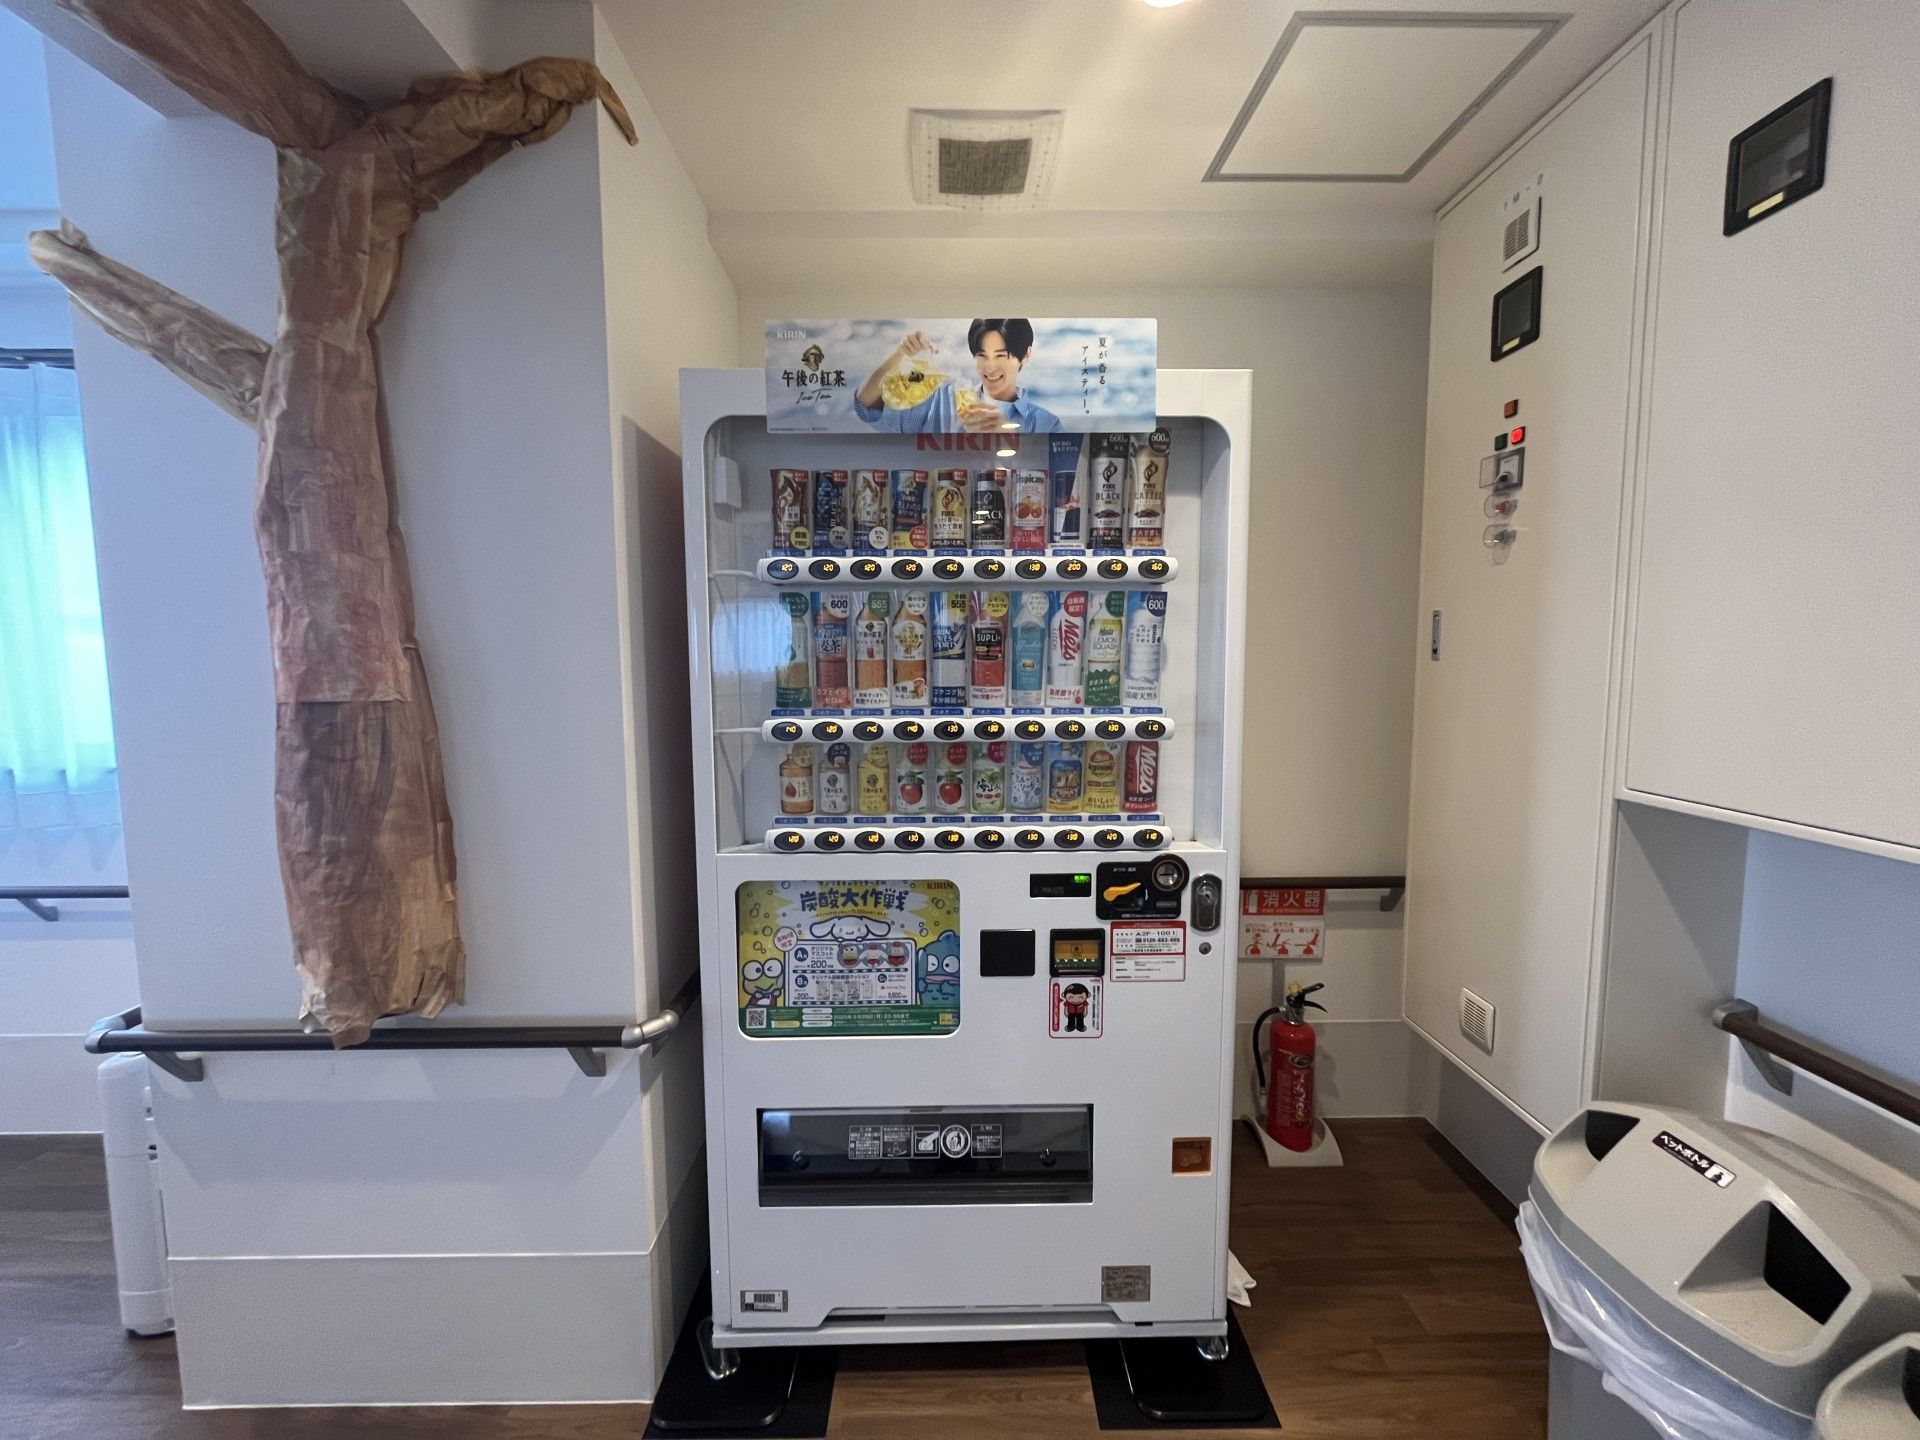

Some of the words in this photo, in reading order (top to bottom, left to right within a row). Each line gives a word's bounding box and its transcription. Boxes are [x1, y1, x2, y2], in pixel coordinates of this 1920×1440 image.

[776, 330, 806, 340] KIRIN
[781, 369, 847, 388] 午後の紅茶
[1095, 493, 1121, 501] BLACK
[831, 600, 848, 609] 600
[1148, 600, 1164, 610] 600
[800, 888, 909, 912] 炭酸大作戦
[1263, 888, 1321, 908] 消火器
[1660, 1135, 1711, 1168] ペットボトル
